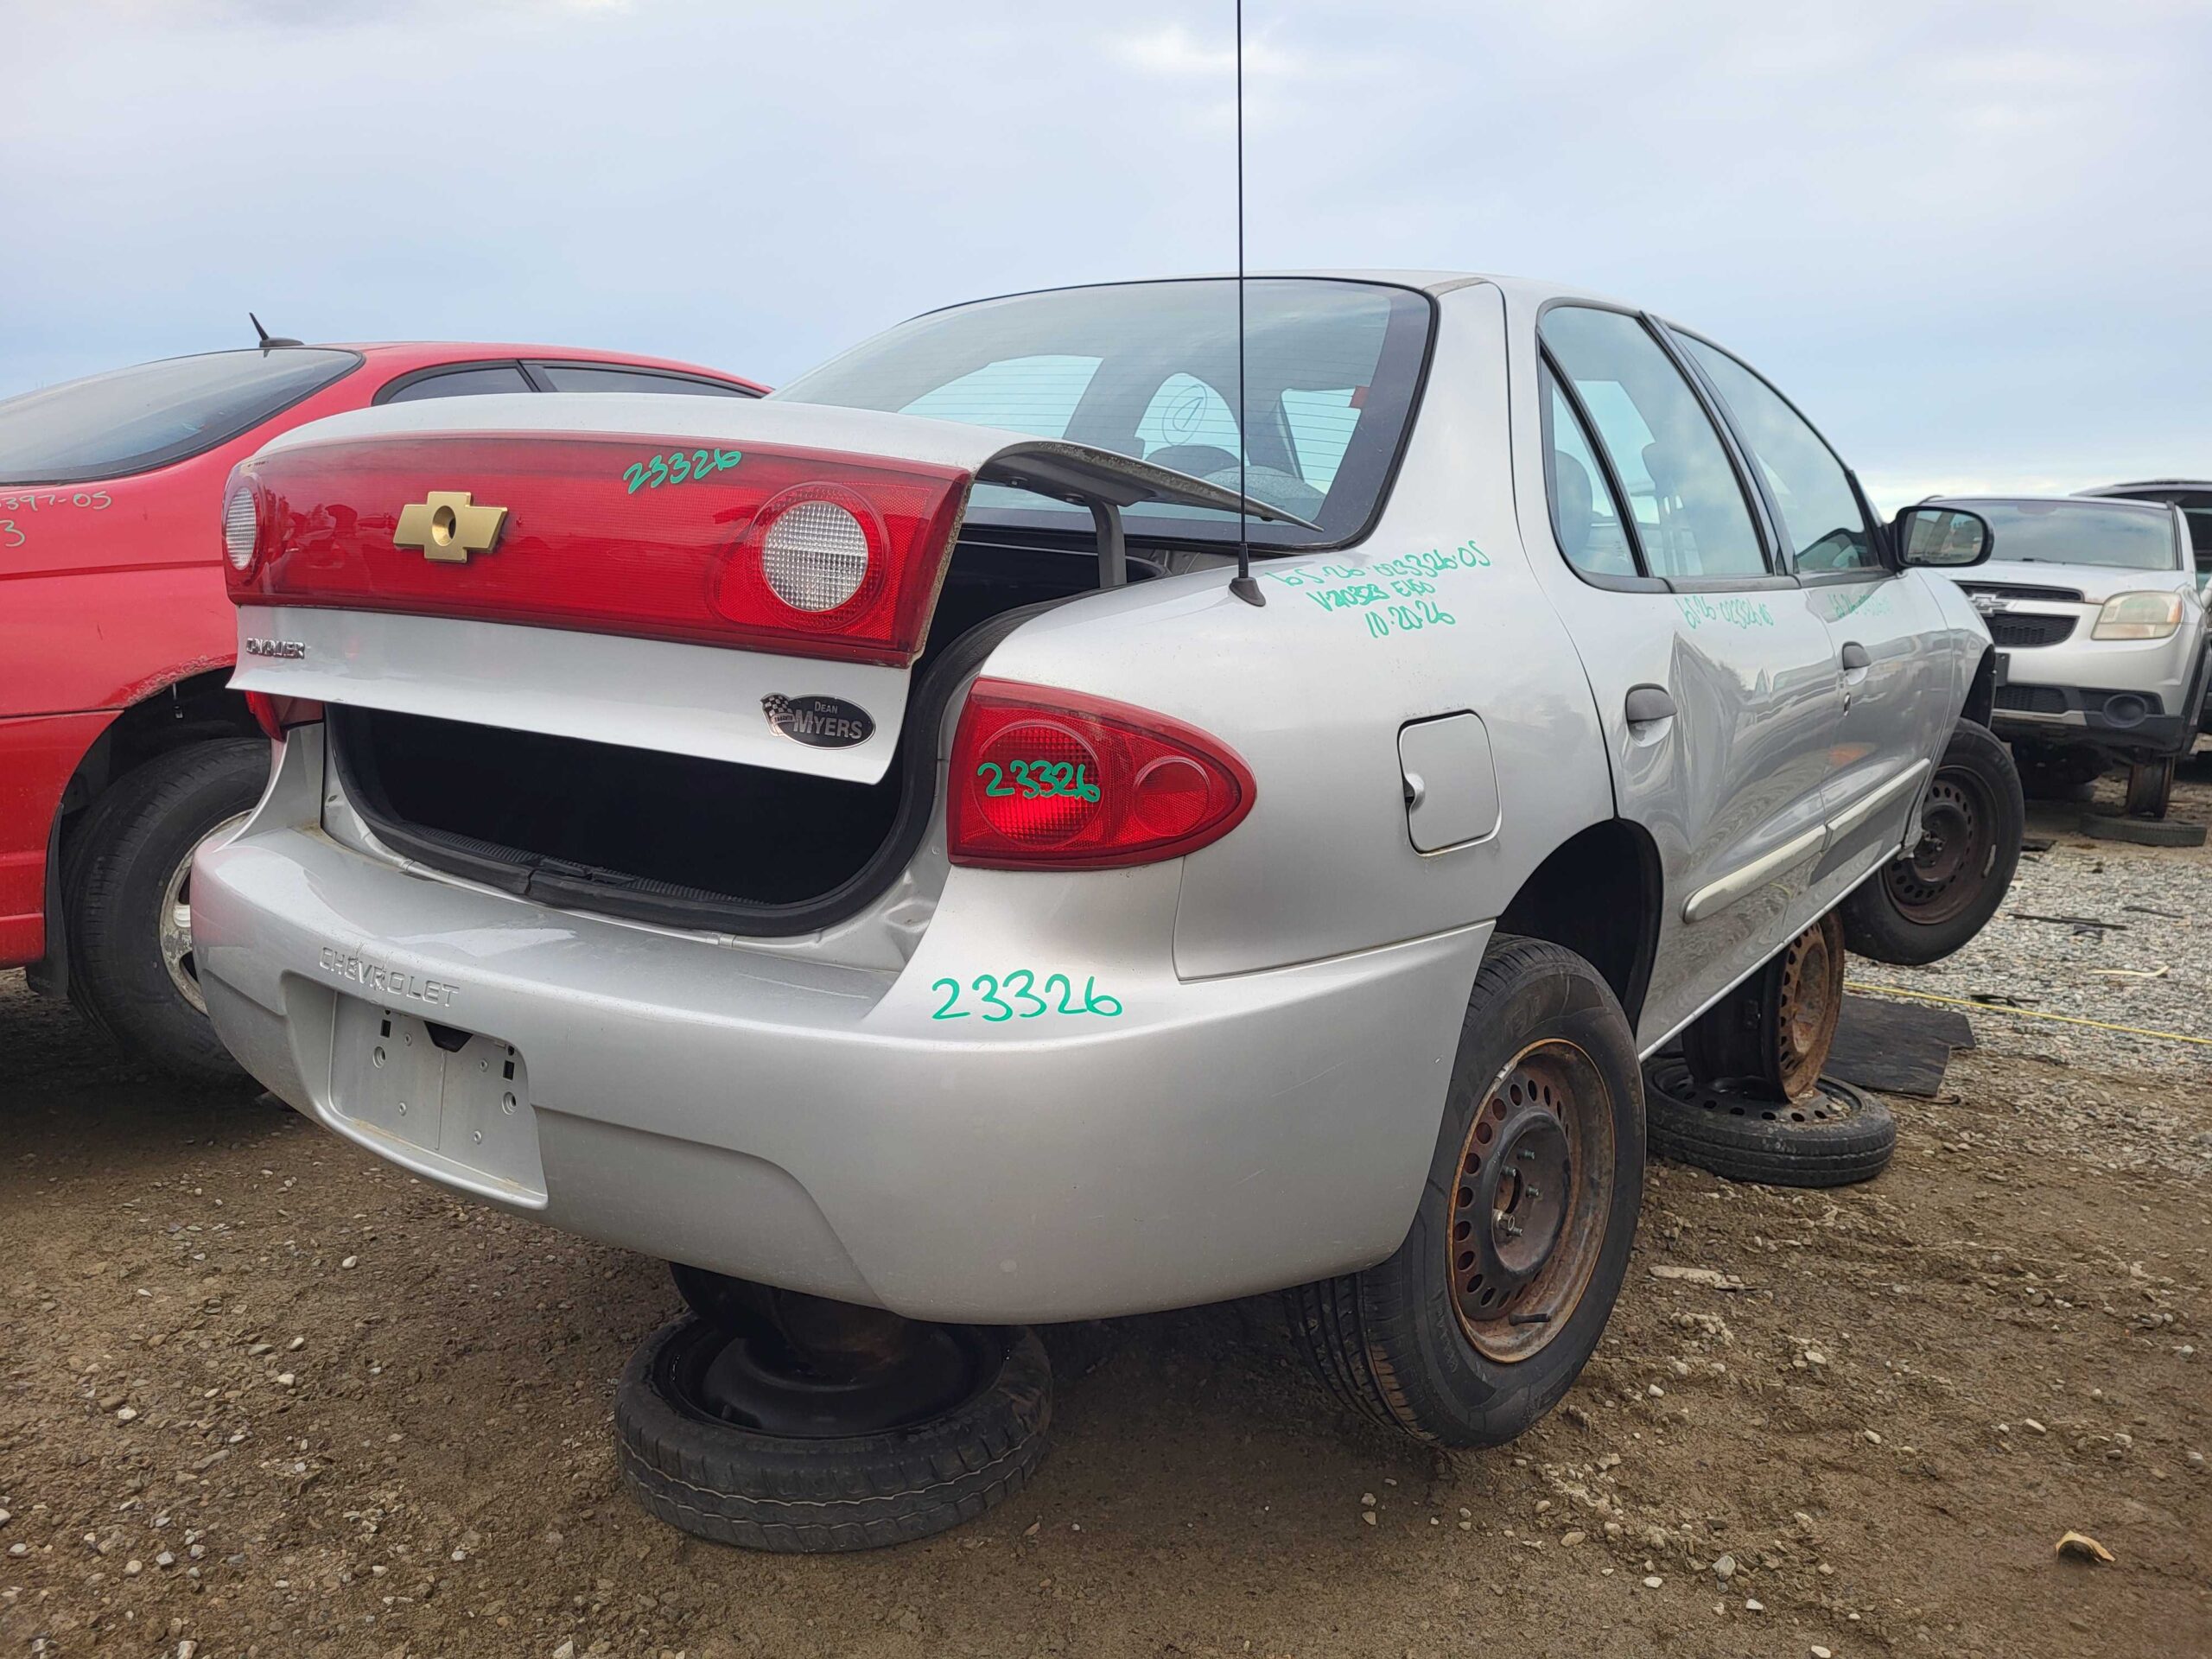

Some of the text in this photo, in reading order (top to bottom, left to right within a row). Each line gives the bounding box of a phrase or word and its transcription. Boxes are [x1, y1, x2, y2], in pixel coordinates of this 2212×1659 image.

[623, 448, 742, 495] 23326
[0, 490, 112, 512] 397-05
[793, 709, 863, 740] MYERS
[814, 701, 838, 715] DEAN
[976, 760, 1102, 803] 23326
[319, 946, 461, 1007] CHEVROLET
[931, 969, 1123, 1022] 23326
